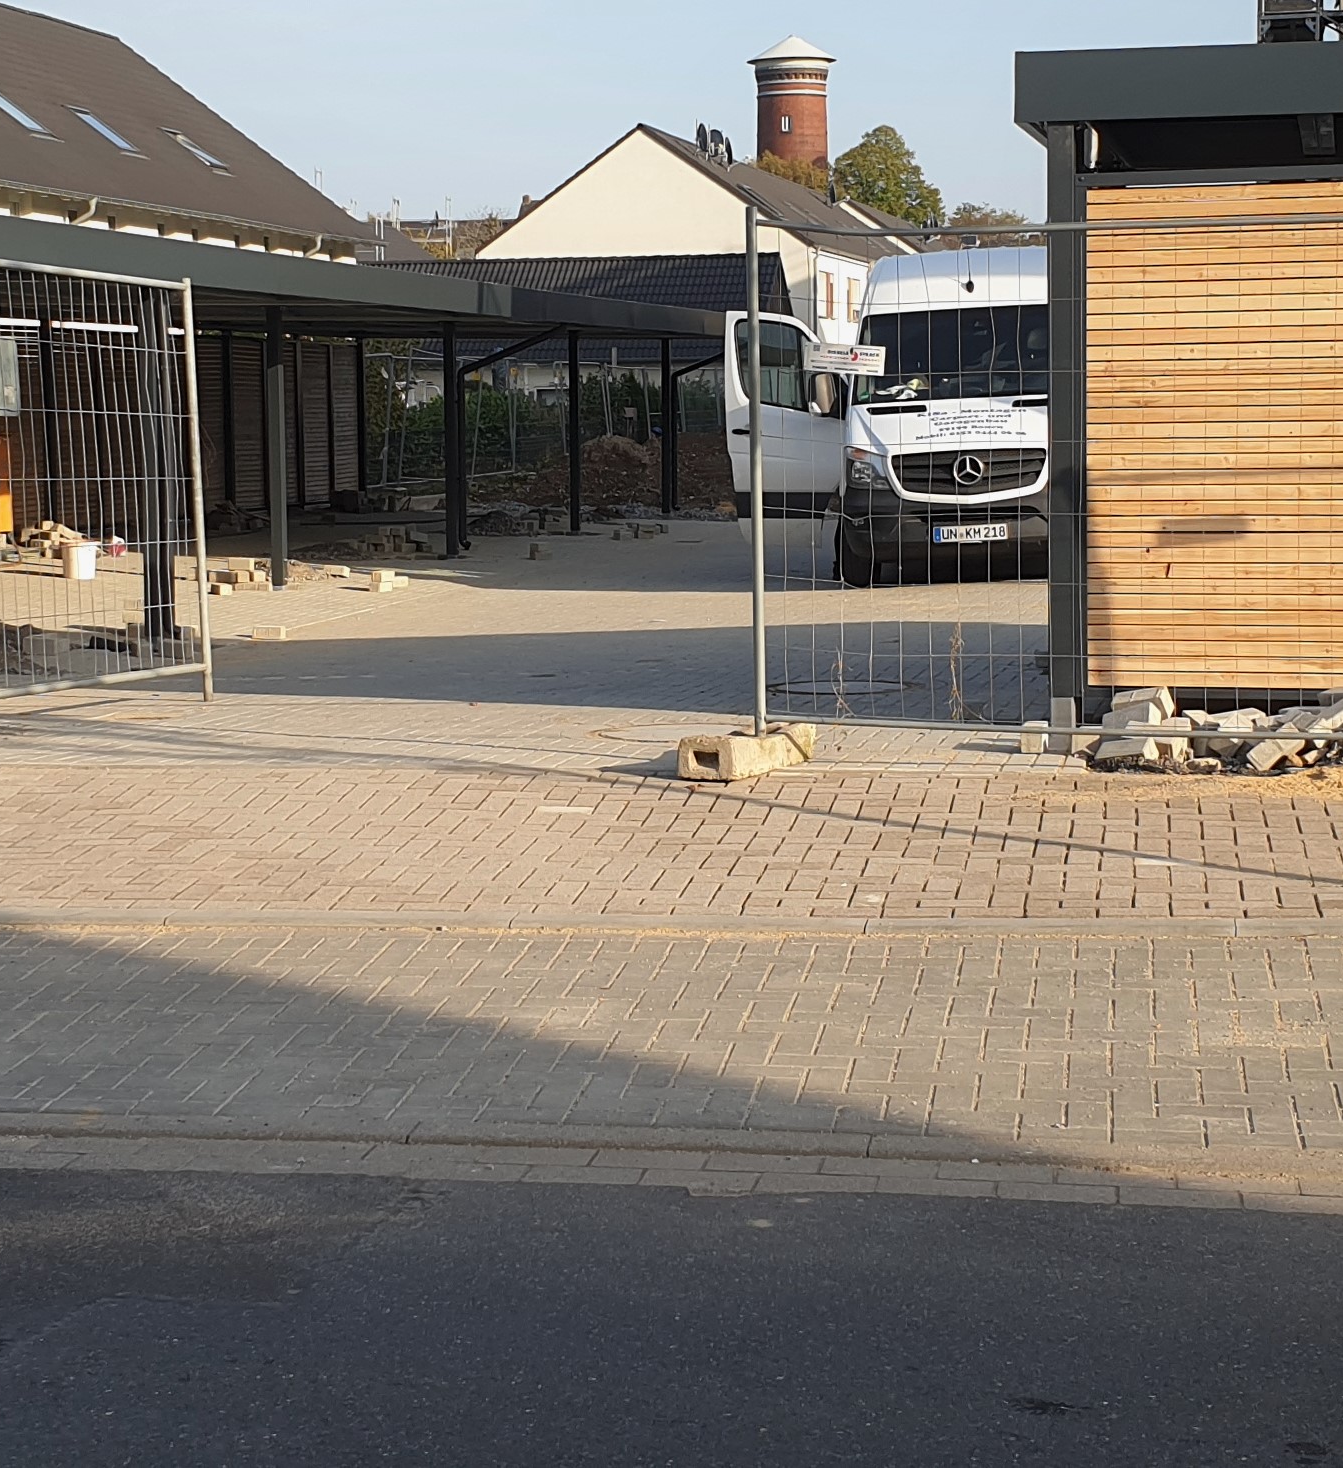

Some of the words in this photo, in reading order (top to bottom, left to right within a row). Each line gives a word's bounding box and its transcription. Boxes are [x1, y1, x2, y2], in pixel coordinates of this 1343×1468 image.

[941, 528, 958, 540] UN
[965, 527, 982, 539] KM
[983, 525, 1006, 538] 218
